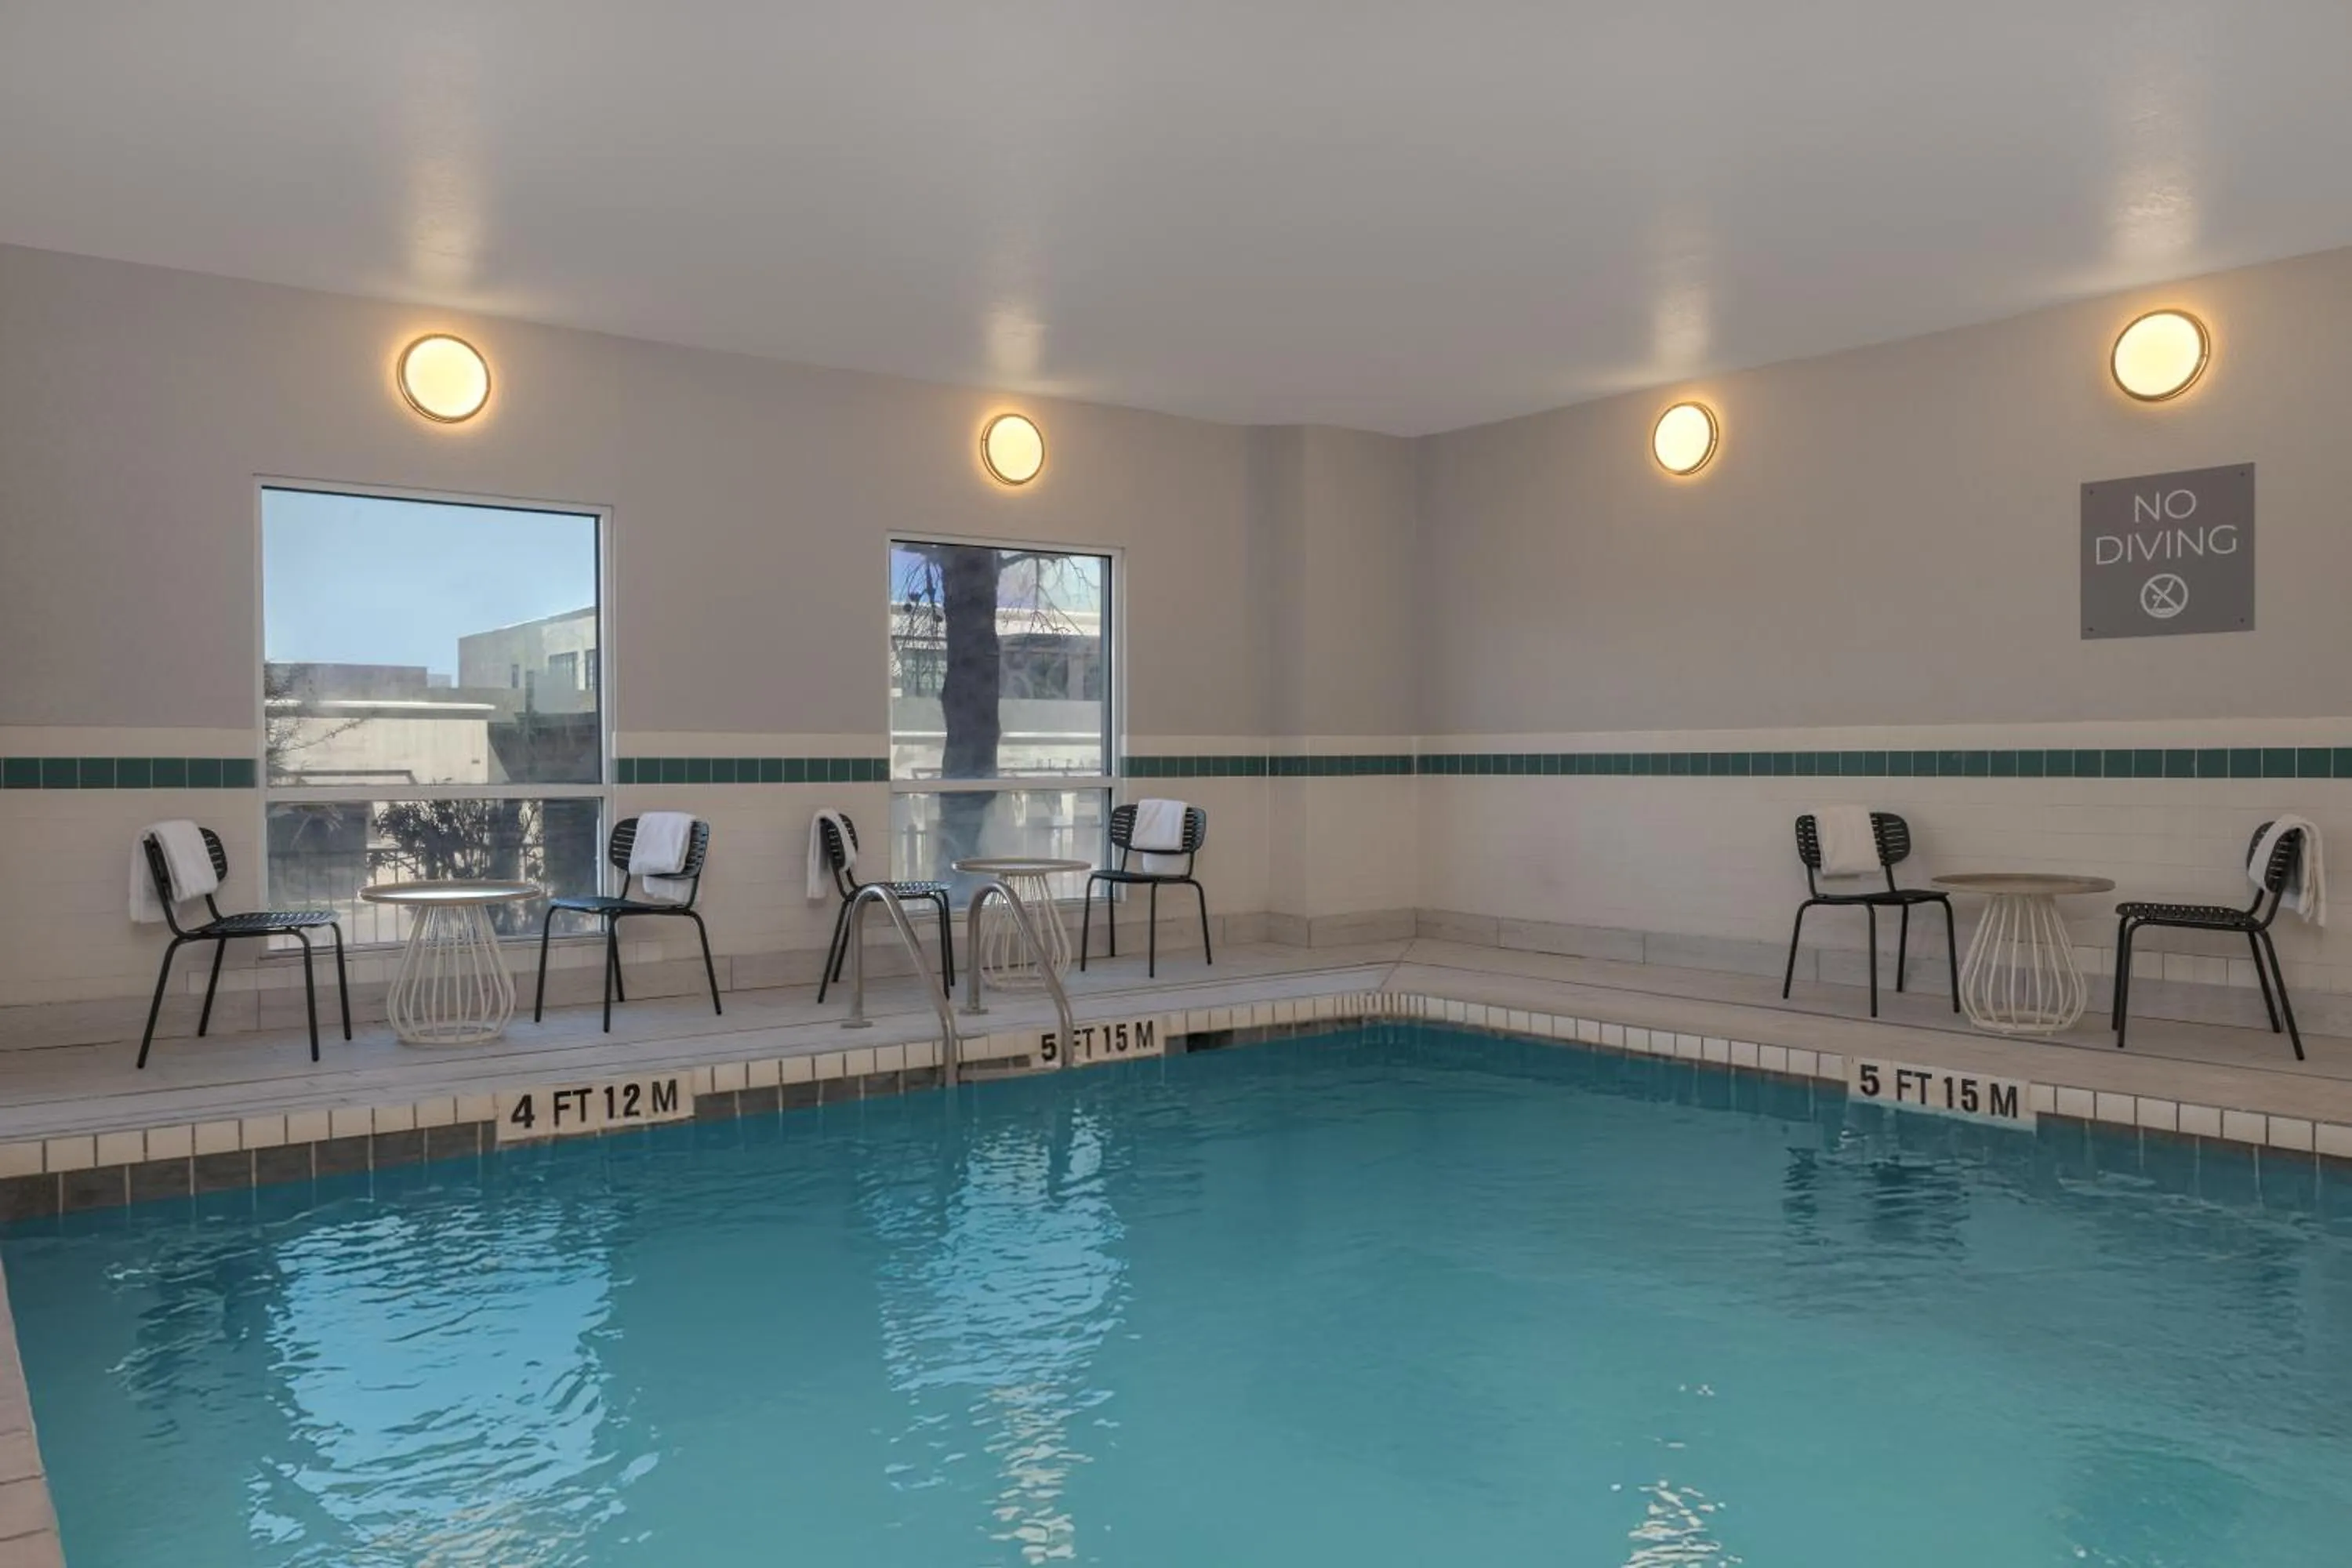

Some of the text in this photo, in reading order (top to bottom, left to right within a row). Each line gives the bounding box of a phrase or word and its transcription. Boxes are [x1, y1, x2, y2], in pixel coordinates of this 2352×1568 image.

[2134, 489, 2197, 523] NO
[2095, 524, 2238, 564] DIVING
[1040, 1033, 1057, 1061] 5
[1136, 1020, 1154, 1048] M
[510, 1094, 535, 1128] 4
[554, 1088, 593, 1127] FT
[652, 1079, 678, 1113] M
[1860, 1064, 1880, 1096] 5
[1896, 1069, 1933, 1105] FT
[1990, 1083, 2018, 1119] M
